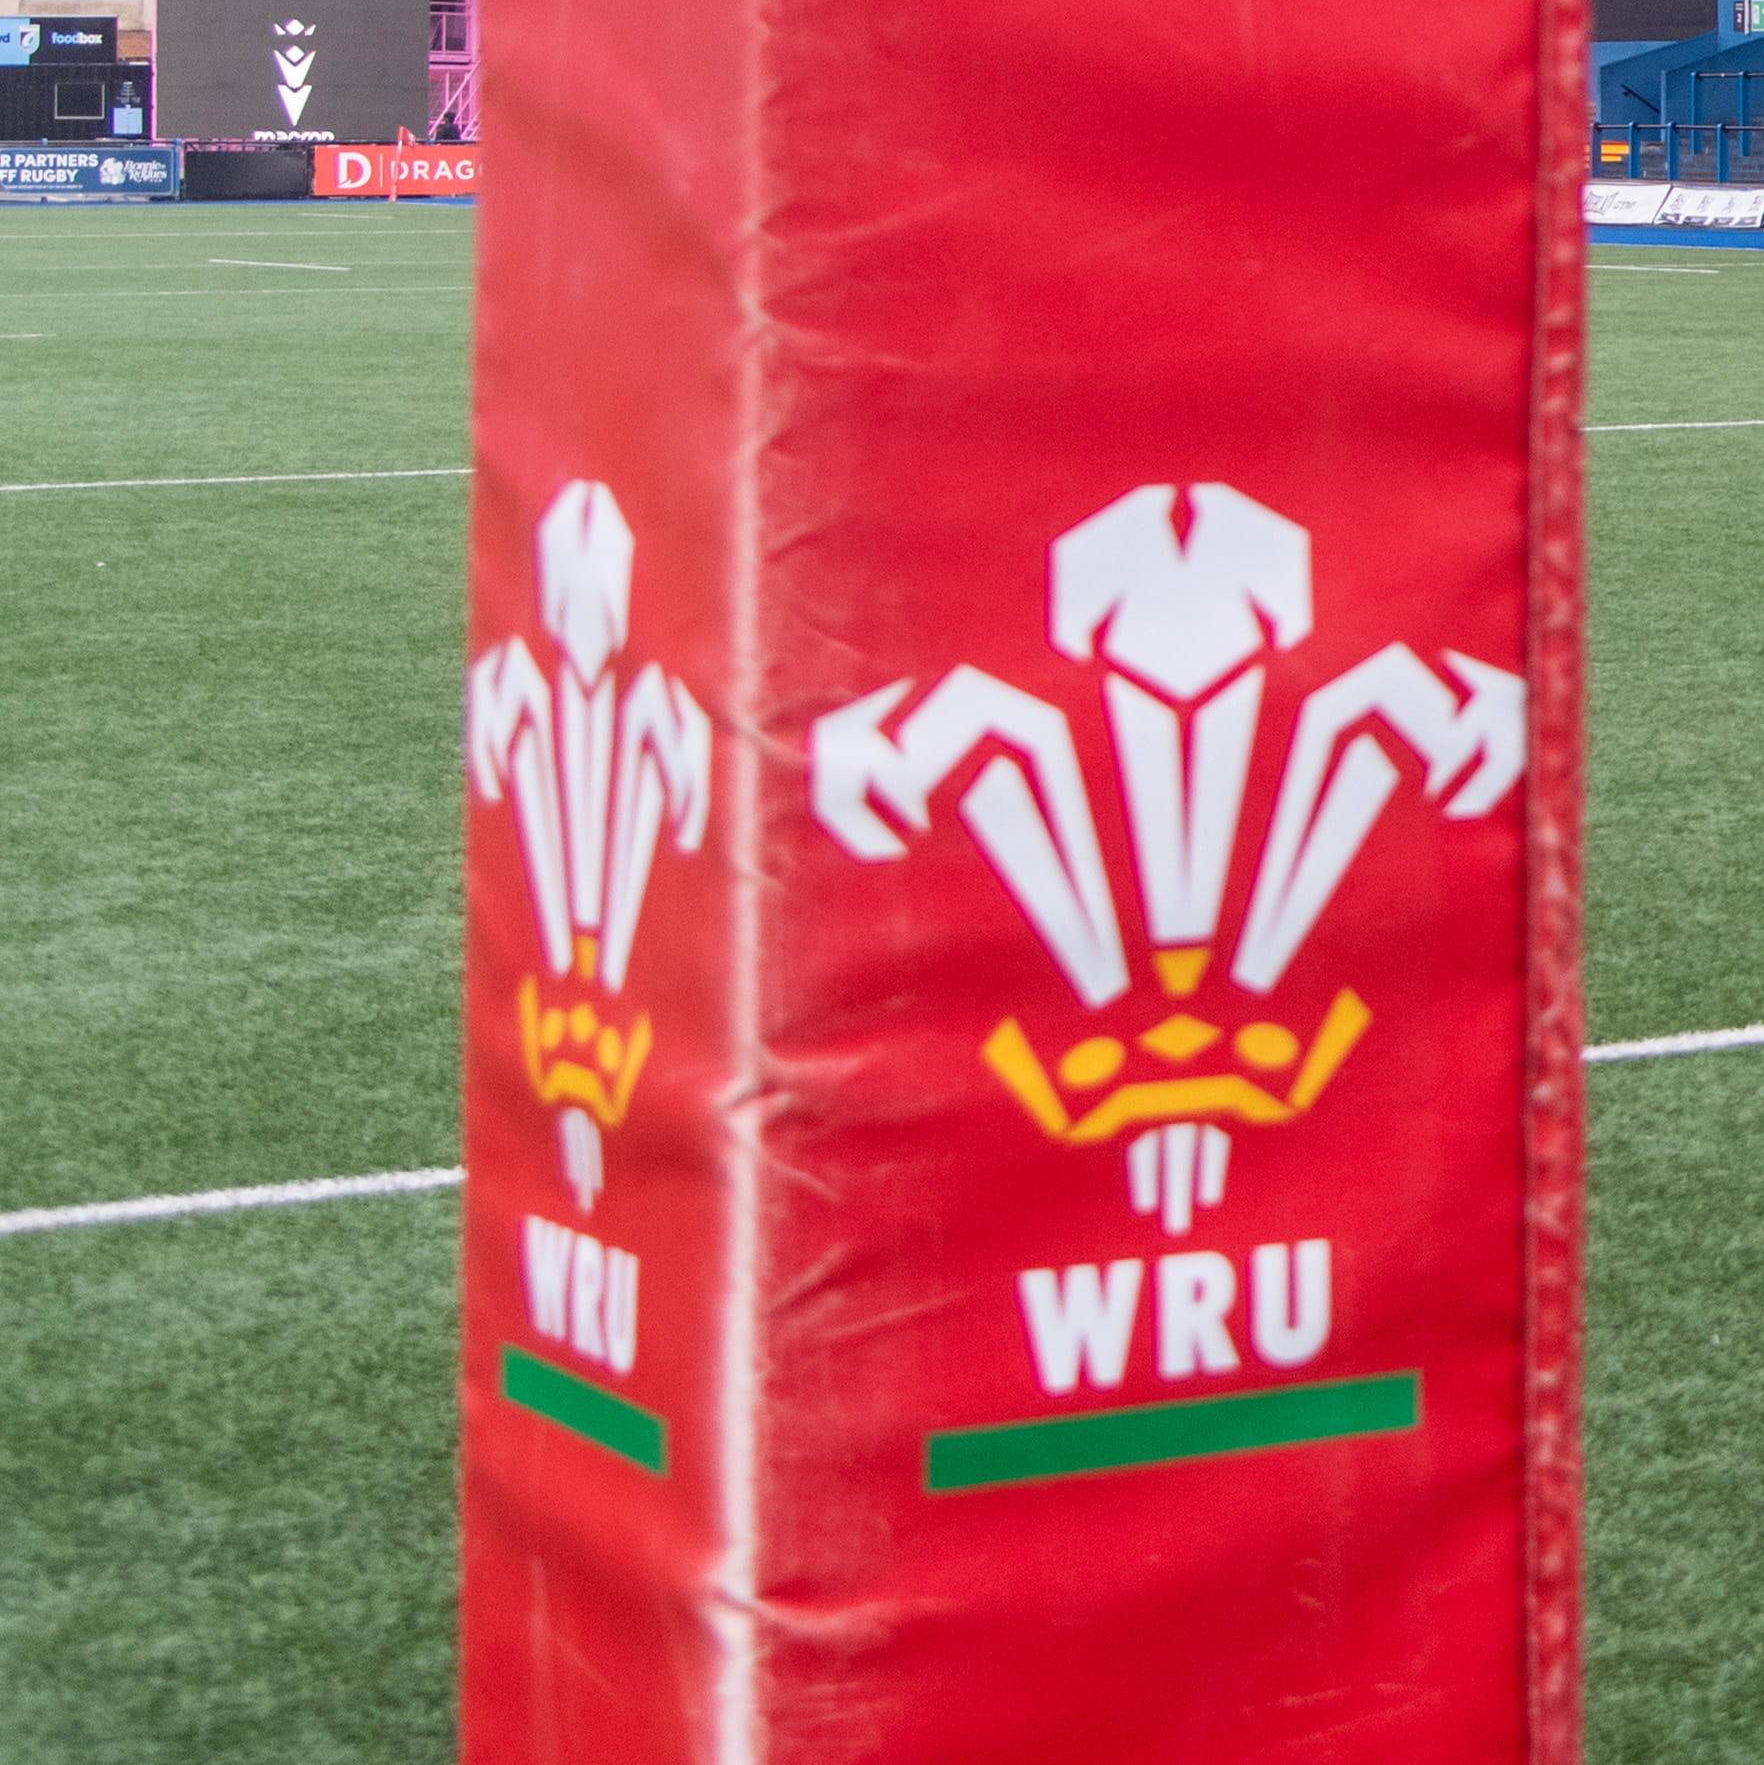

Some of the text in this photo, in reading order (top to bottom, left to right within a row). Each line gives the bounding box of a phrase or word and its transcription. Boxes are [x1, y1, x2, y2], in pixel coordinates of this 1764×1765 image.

[51, 32, 103, 45] foodbox
[15, 154, 99, 167] PARTNERS
[20, 169, 79, 183] RUGBY
[391, 160, 482, 181] DRAG
[521, 1215, 640, 1375] WRU
[1017, 1237, 1332, 1395] WRU
